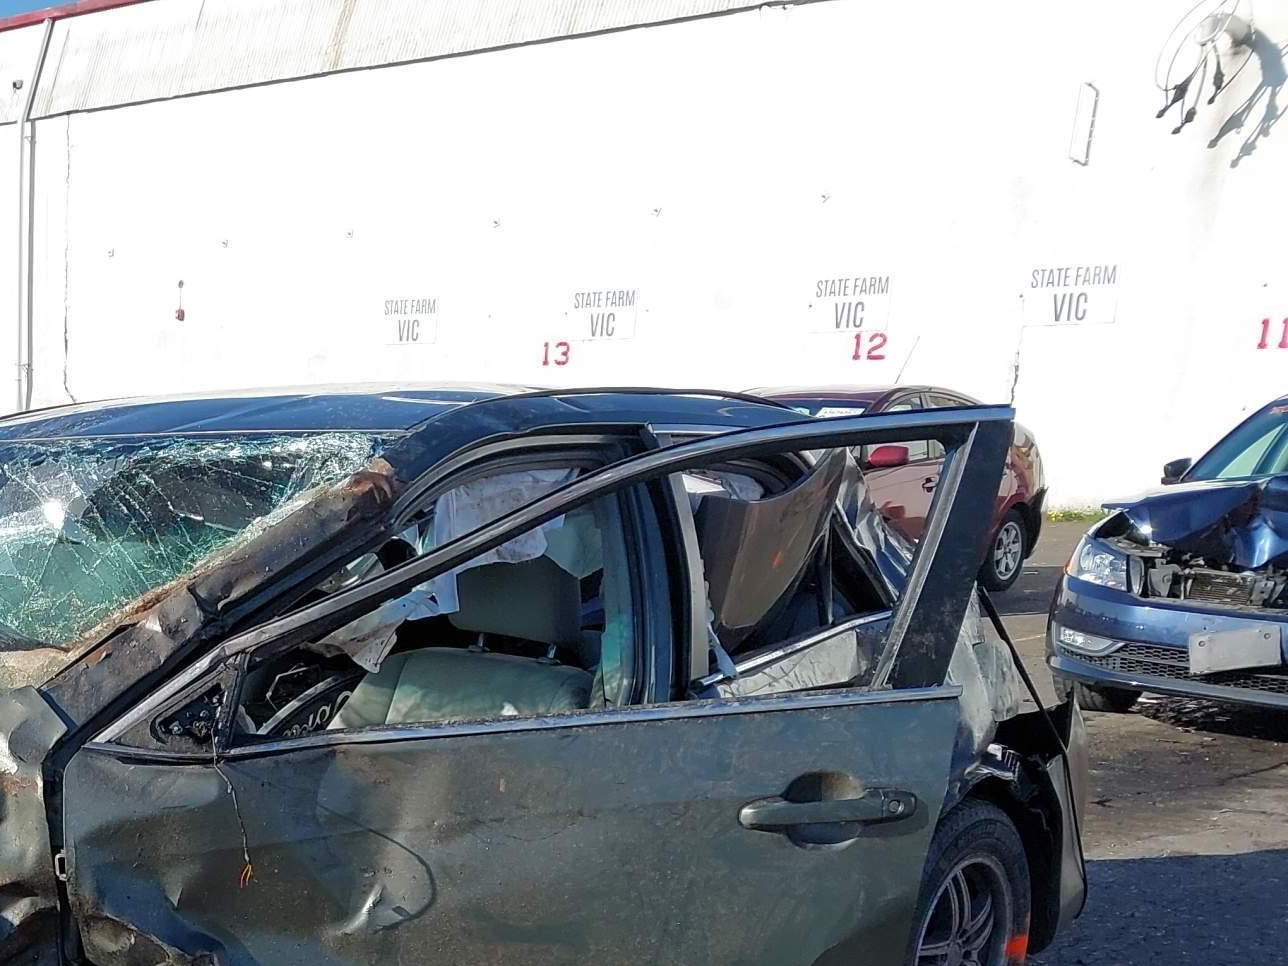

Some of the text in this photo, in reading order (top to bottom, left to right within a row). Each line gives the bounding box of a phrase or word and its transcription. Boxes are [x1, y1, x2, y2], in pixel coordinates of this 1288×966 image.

[815, 275, 891, 298] STATE FARM
[1030, 264, 1118, 289] STATE FARM
[384, 297, 437, 316] STATE FARM
[573, 289, 636, 310] STATE FARM
[1053, 293, 1088, 323] VIC
[590, 312, 616, 338] VIC
[834, 301, 865, 329] VIC
[398, 319, 420, 342] VIC
[1256, 317, 1288, 350] 11
[542, 341, 571, 367] 13
[851, 332, 889, 362] 12
